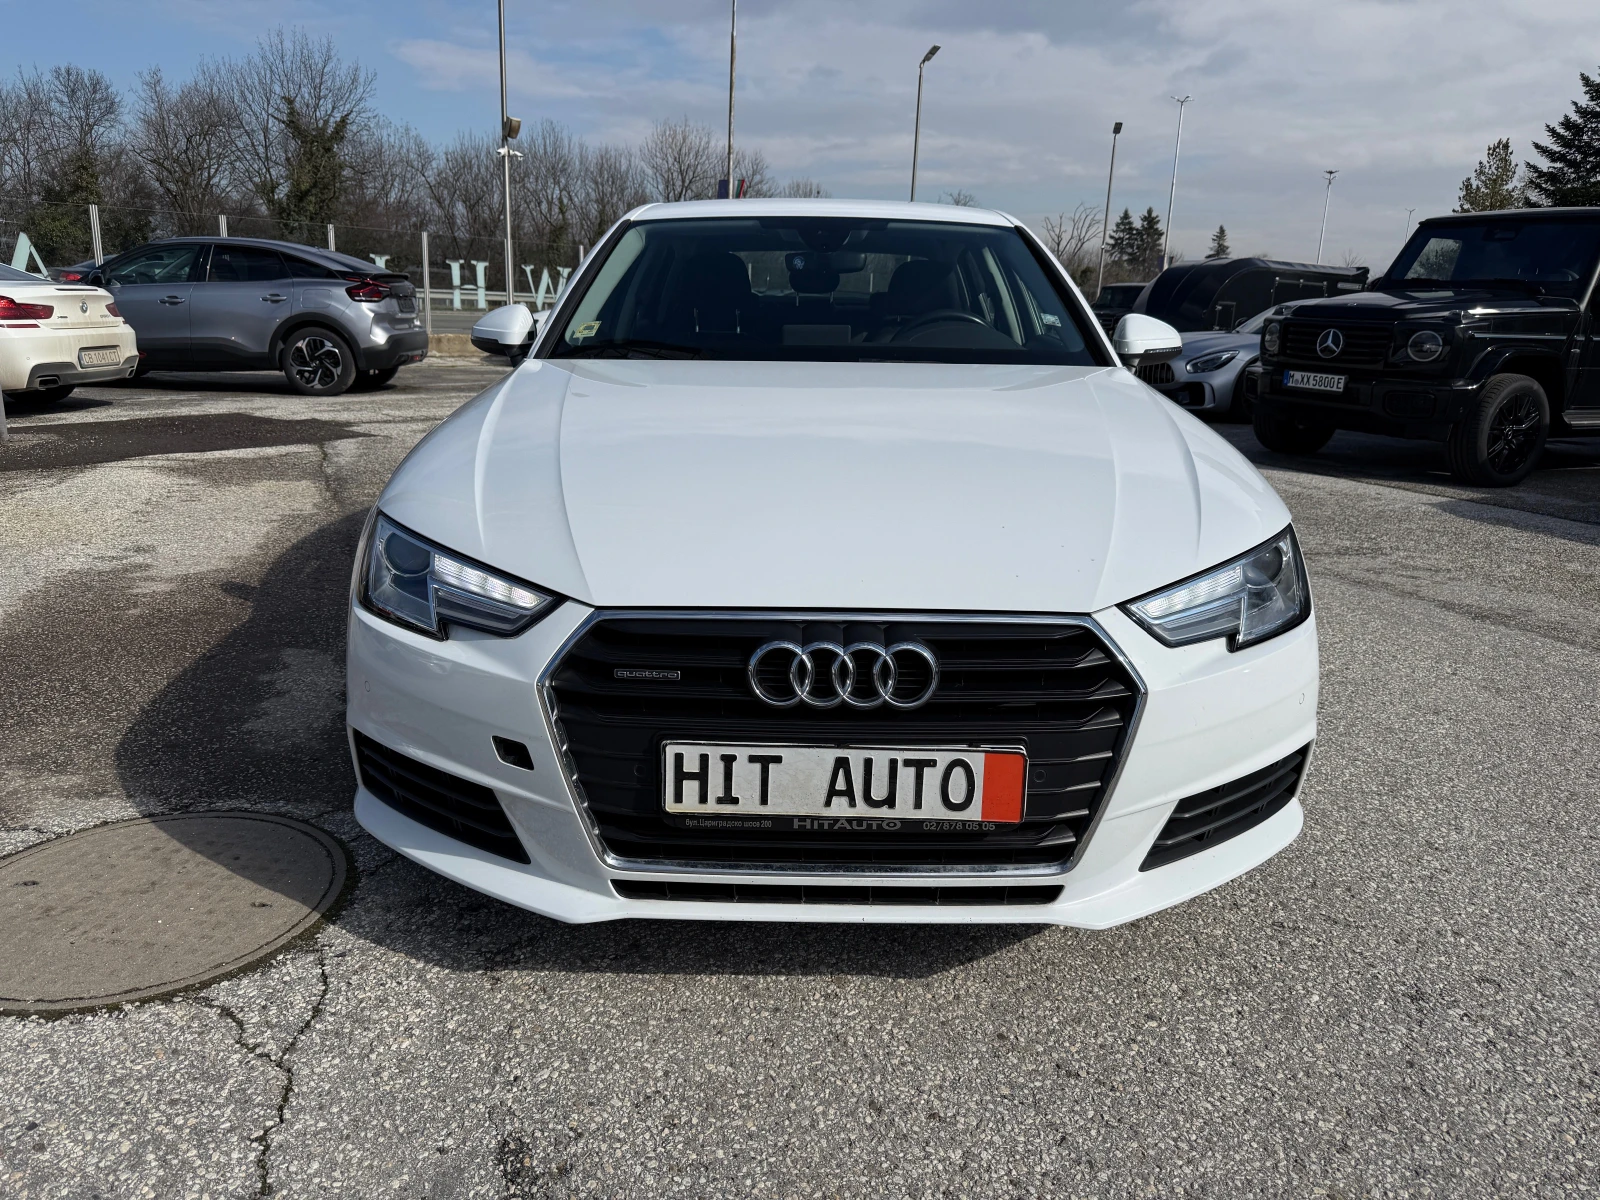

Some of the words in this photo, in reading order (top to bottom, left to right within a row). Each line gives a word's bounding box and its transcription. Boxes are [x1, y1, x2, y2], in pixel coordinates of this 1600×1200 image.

[617, 670, 679, 680] quattro
[674, 753, 783, 806] HIT
[823, 756, 976, 812] AUTO
[760, 820, 772, 828] 200
[922, 821, 963, 832] 02/878
[965, 822, 979, 831] 05
[982, 822, 996, 831] 05
